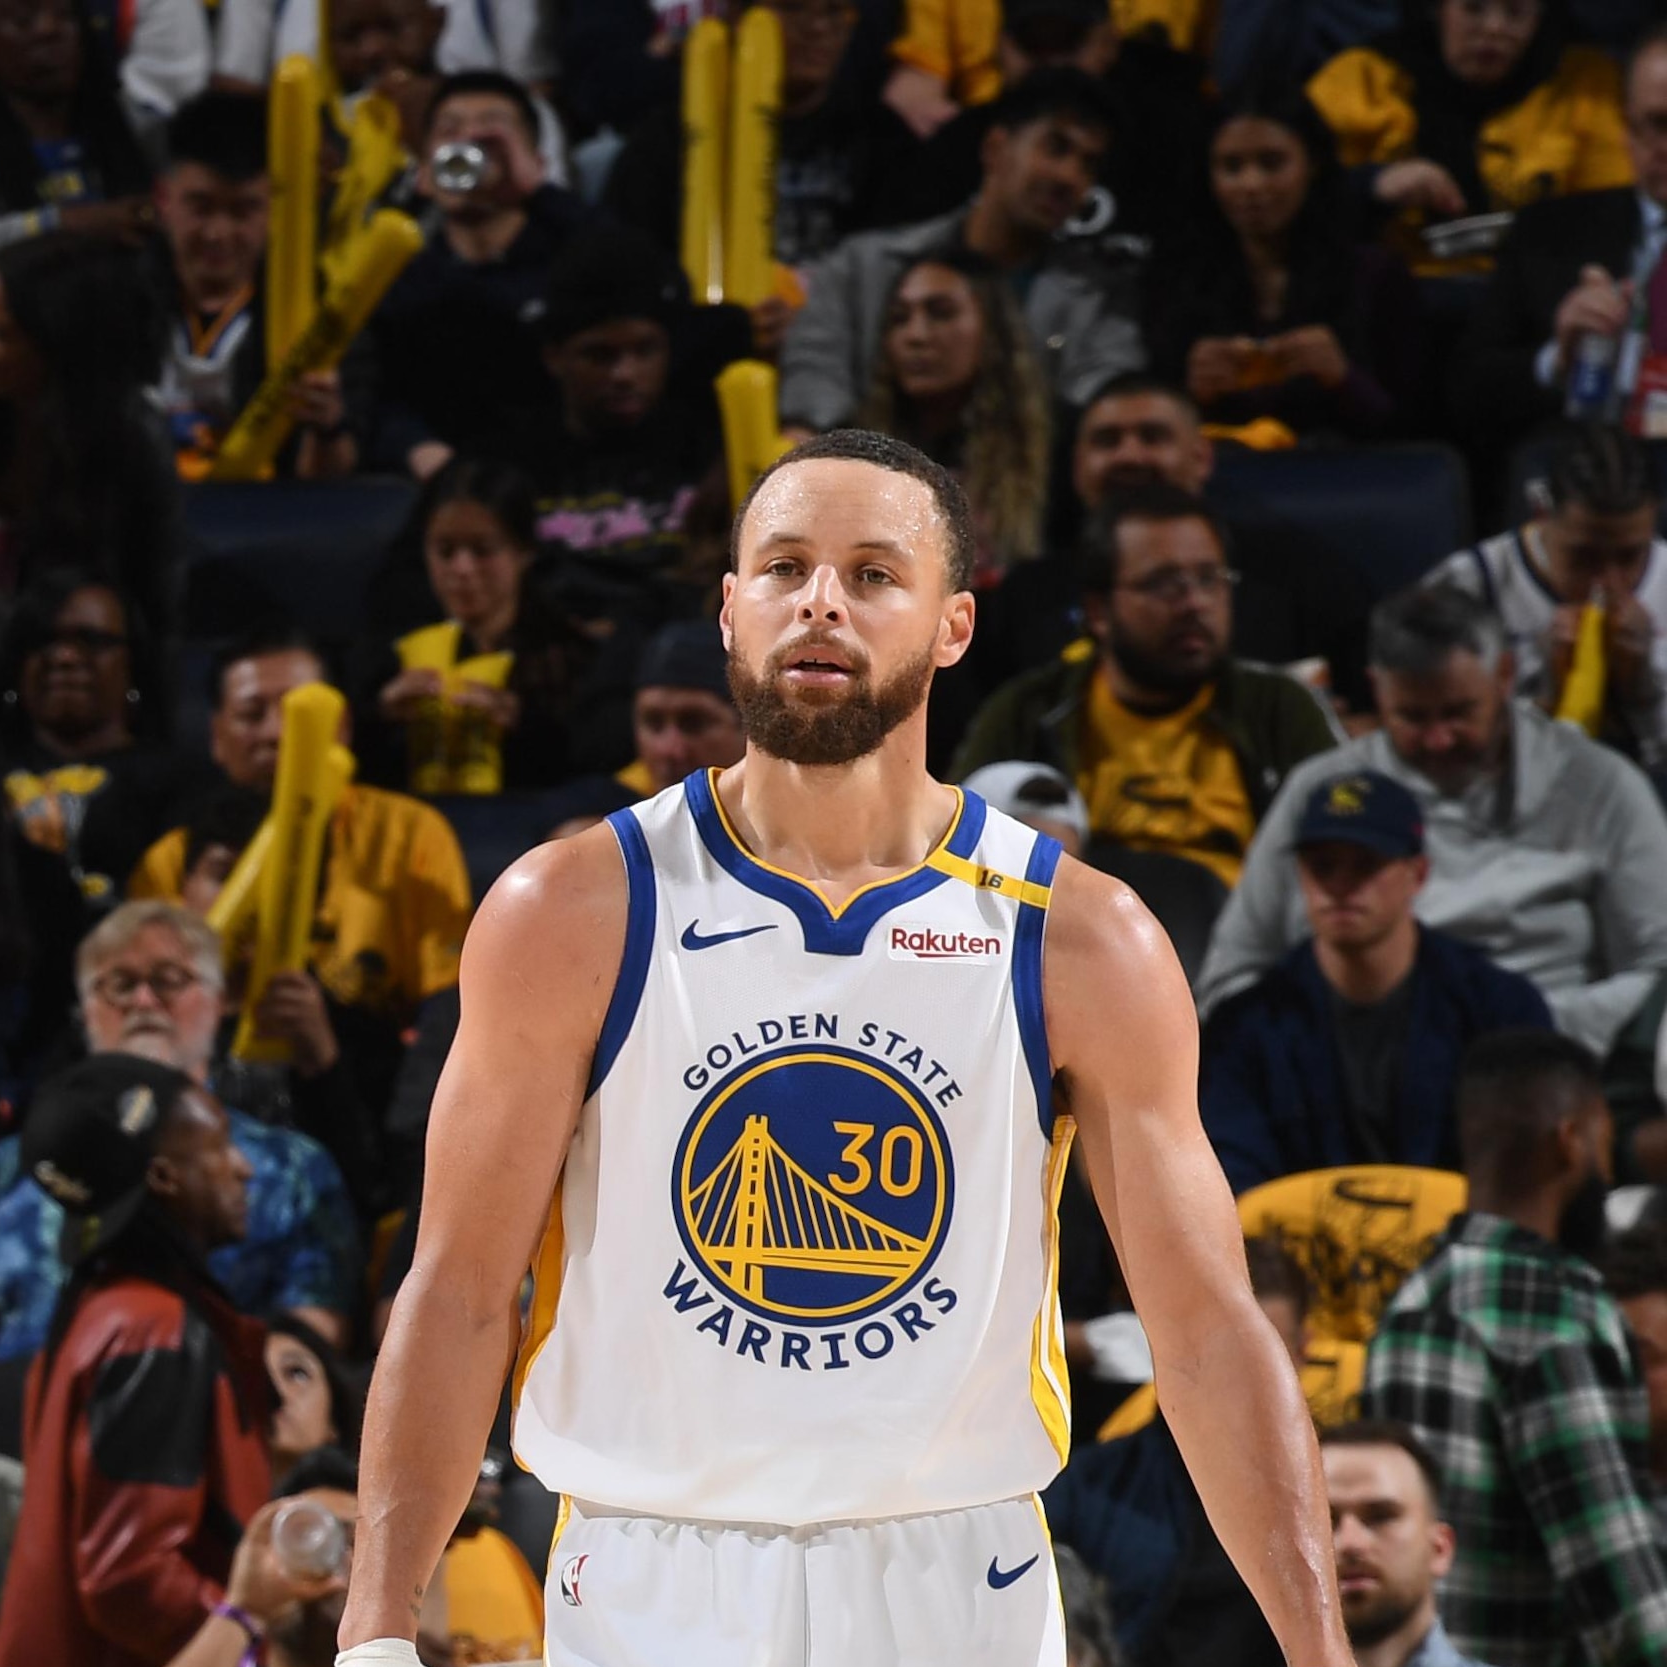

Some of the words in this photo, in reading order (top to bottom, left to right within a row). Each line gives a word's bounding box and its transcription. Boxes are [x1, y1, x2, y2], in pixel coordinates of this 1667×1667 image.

[979, 869, 1004, 889] 16
[891, 928, 1001, 956] Rakuten
[683, 1013, 839, 1092] GOLDEN
[858, 1022, 964, 1108] STATE
[827, 1121, 924, 1197] 30
[662, 1258, 958, 1371] WARRIORS
